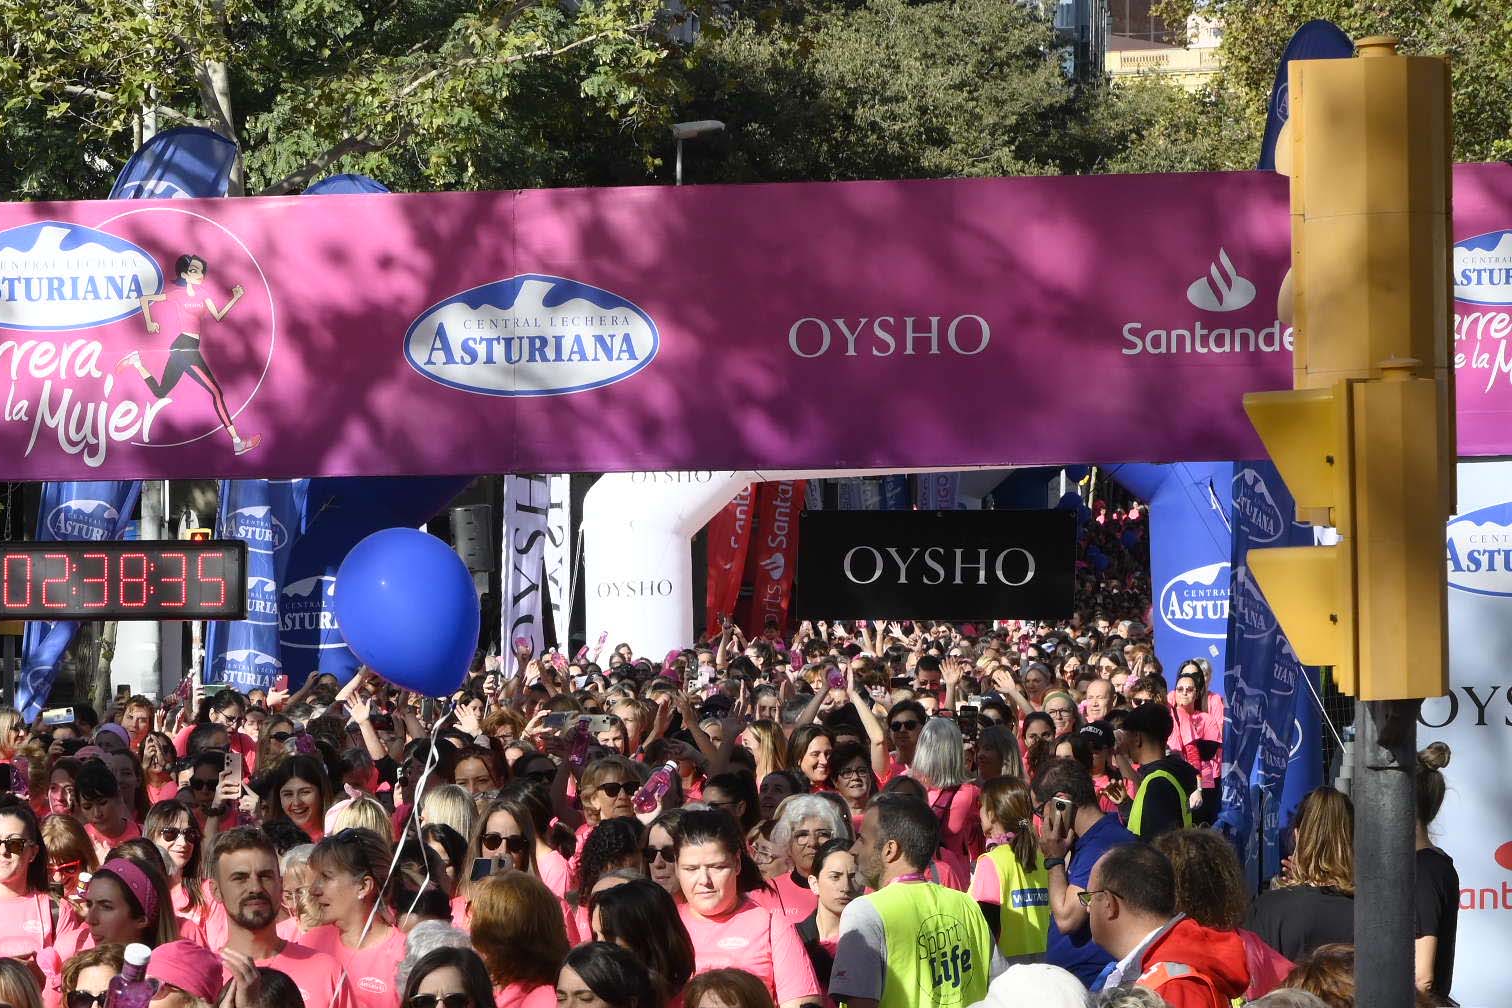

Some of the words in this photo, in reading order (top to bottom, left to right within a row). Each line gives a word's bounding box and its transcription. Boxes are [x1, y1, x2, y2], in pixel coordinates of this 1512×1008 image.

[423, 321, 639, 366] ASTURIANA
[463, 316, 541, 331] CENTRAL
[549, 315, 632, 329] LECHERA
[788, 314, 991, 358] OYSHO
[1121, 321, 1294, 356] Santande
[1472, 341, 1490, 369] la
[4, 381, 28, 422] la
[25, 374, 173, 468] Mujer
[2, 553, 226, 607] 02:38:35
[844, 545, 1035, 586] OYSHO
[597, 579, 673, 599] OYSHO
[918, 923, 962, 961] Sport
[929, 945, 972, 989] Life
